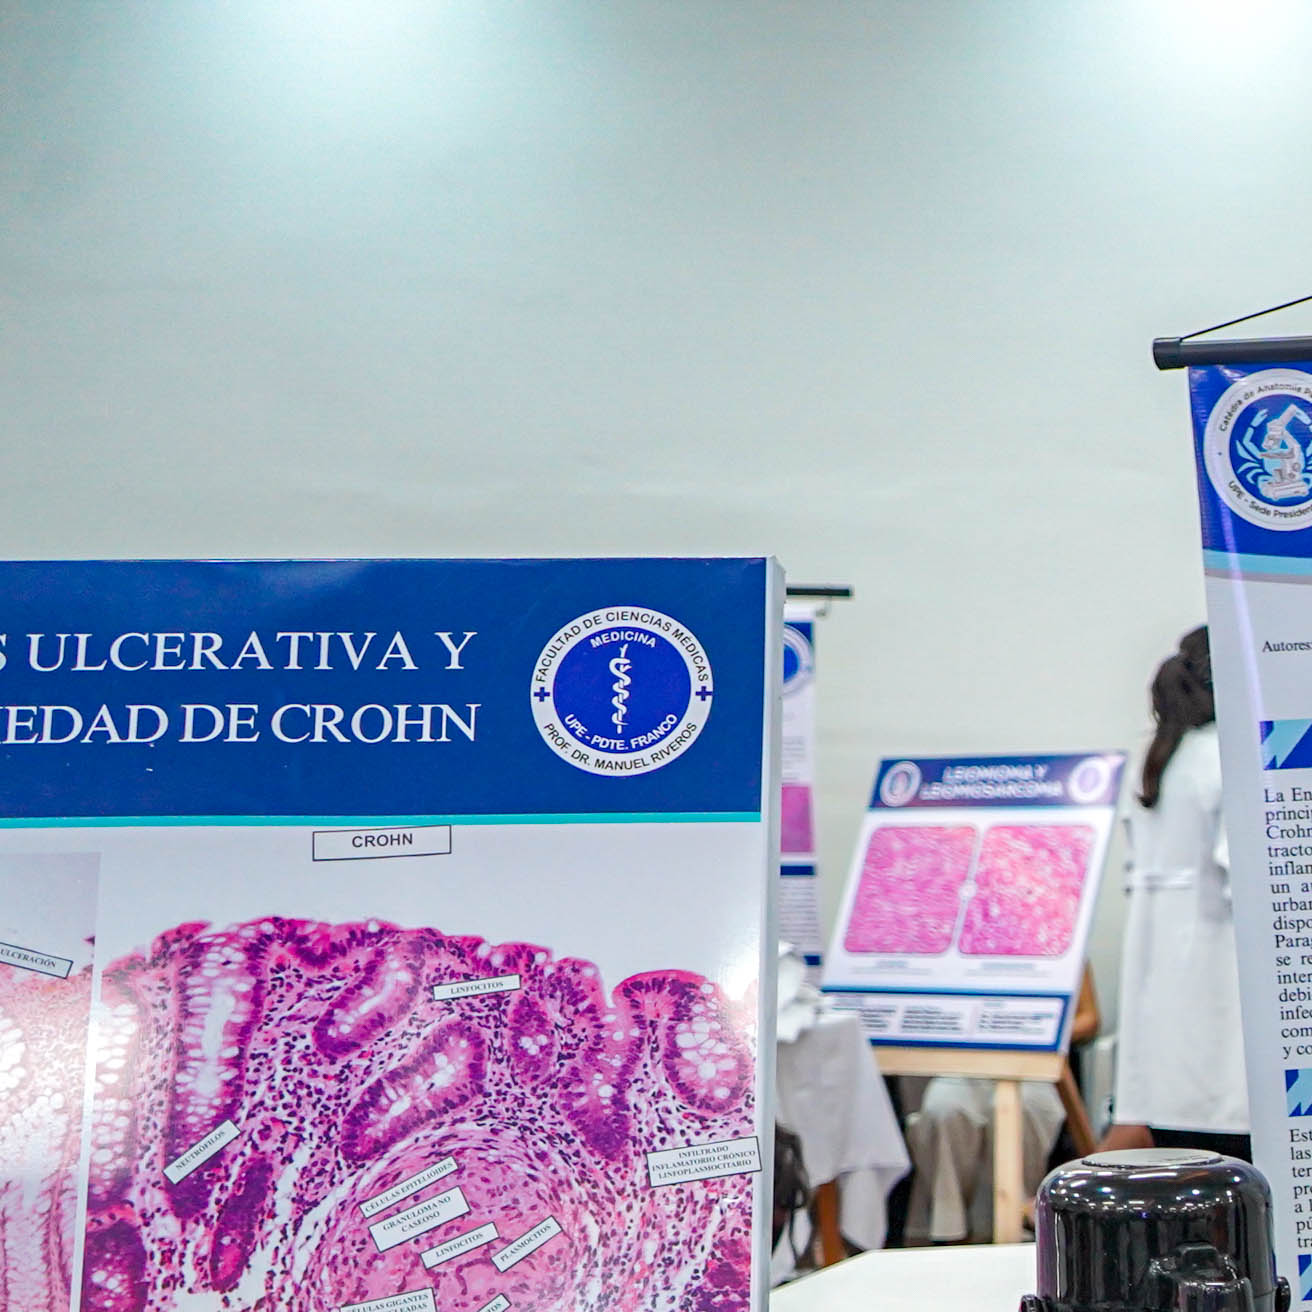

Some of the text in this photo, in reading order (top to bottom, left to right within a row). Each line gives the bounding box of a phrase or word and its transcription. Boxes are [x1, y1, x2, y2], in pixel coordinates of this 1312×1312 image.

[1228, 480, 1242, 499] UPE
[1250, 501, 1271, 517] Sede
[28, 630, 418, 673] ULCERATIVA
[436, 630, 479, 671] Y
[536, 611, 709, 682] FACULTAD DE CIENCIAS MÉDICAS
[590, 631, 657, 648] MEDICINA
[2, 701, 482, 747] EDAD DE CROHN
[564, 713, 588, 736] UPE
[591, 734, 629, 750] PDTE.
[630, 713, 678, 749] FRANCO
[543, 722, 698, 771] PROF. DR. MANUEL RIVEROS
[1264, 787, 1287, 804] La
[351, 832, 414, 851] CROHN
[652, 1156, 716, 1172] INFLAMATORIO
[679, 1145, 729, 1158] INFILTRADO
[382, 1196, 452, 1231] GRANULOMA NO
[401, 1211, 441, 1233] CASEOSO
[386, 1294, 430, 1308] GIGANTES
